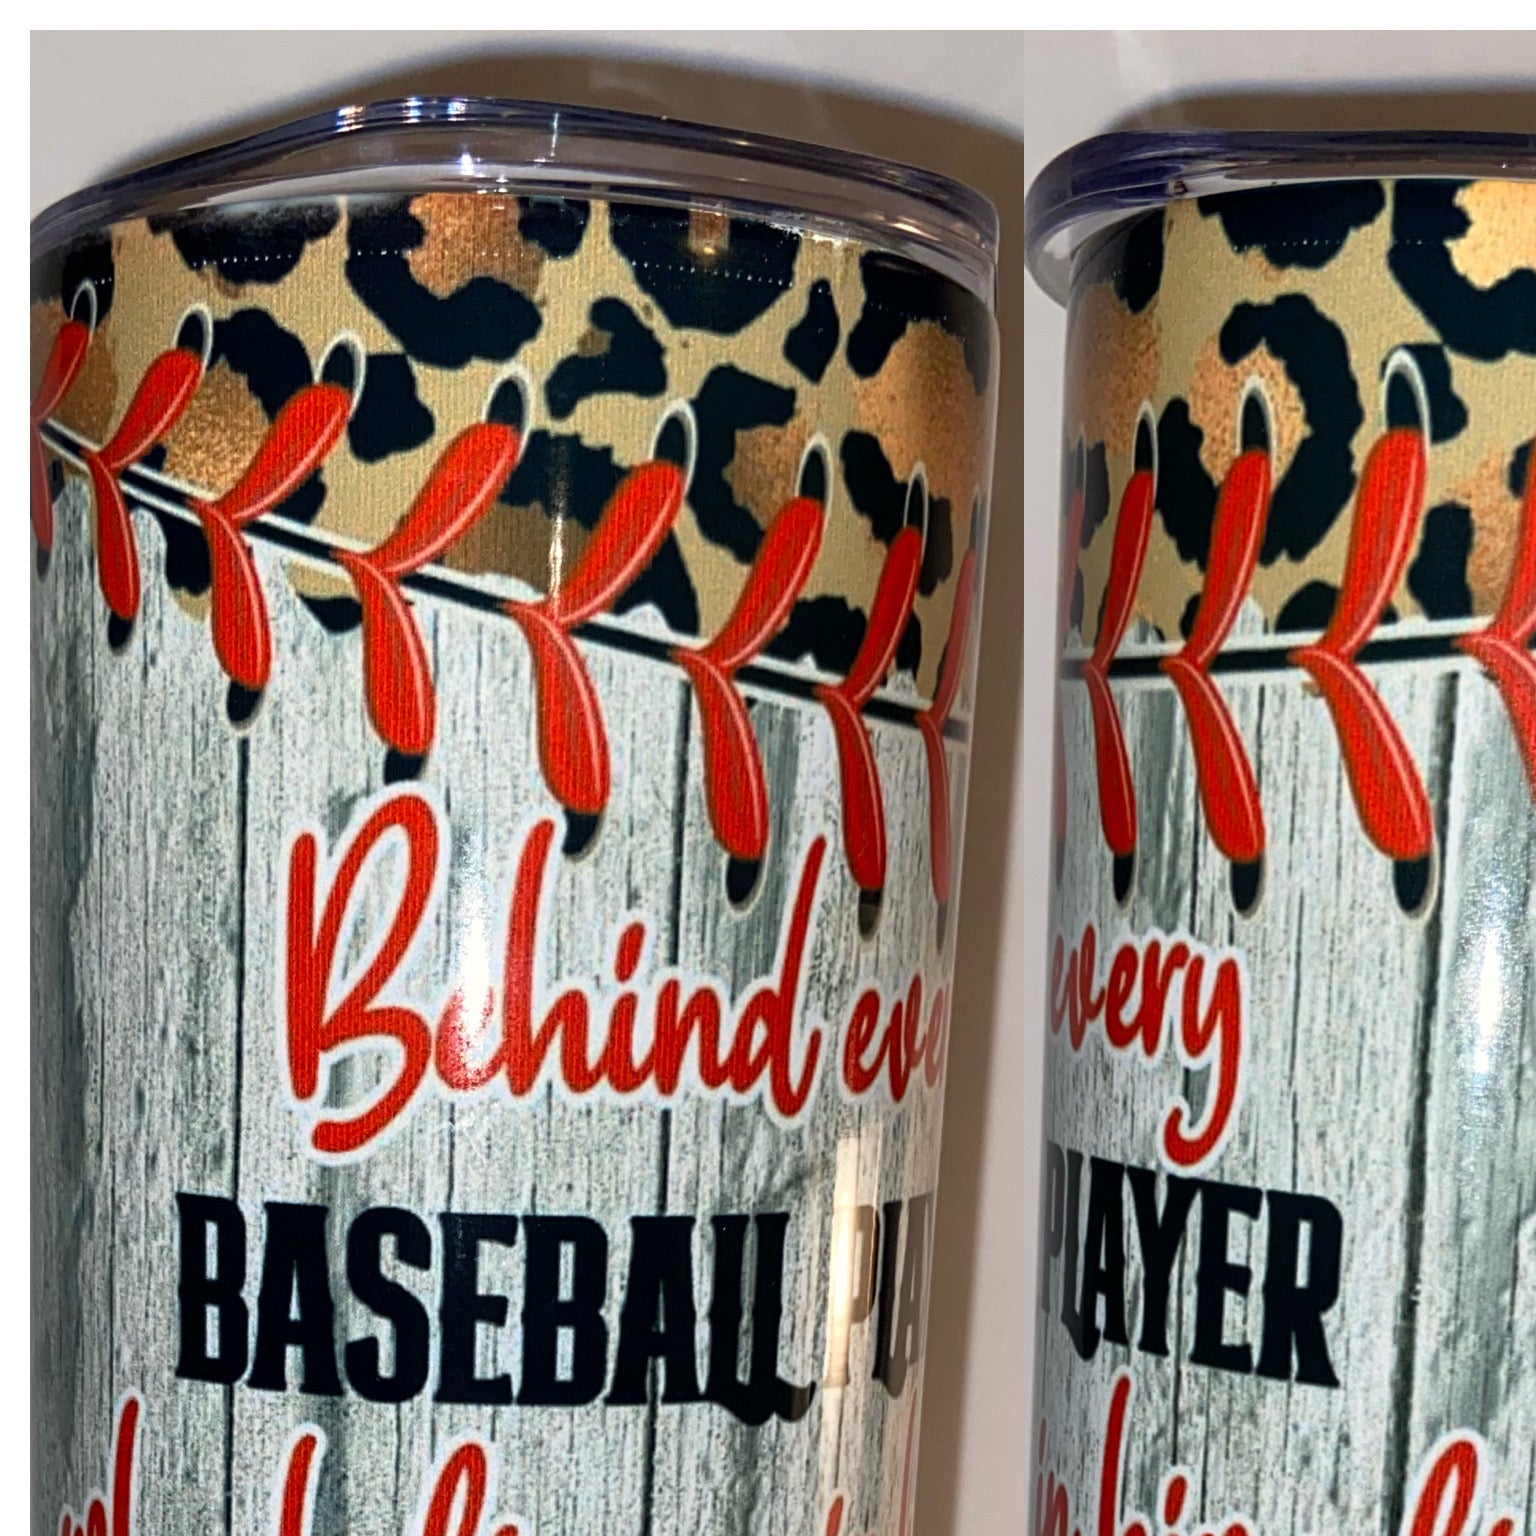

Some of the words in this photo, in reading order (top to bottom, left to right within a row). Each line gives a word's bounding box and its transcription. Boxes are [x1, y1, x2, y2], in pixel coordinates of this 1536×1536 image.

[286, 794, 828, 1156] Behind
[842, 973, 949, 1104] eve
[1050, 922, 1239, 1167] every
[176, 1192, 816, 1427] BASEBALL
[1040, 1139, 1344, 1389] PLAYER
